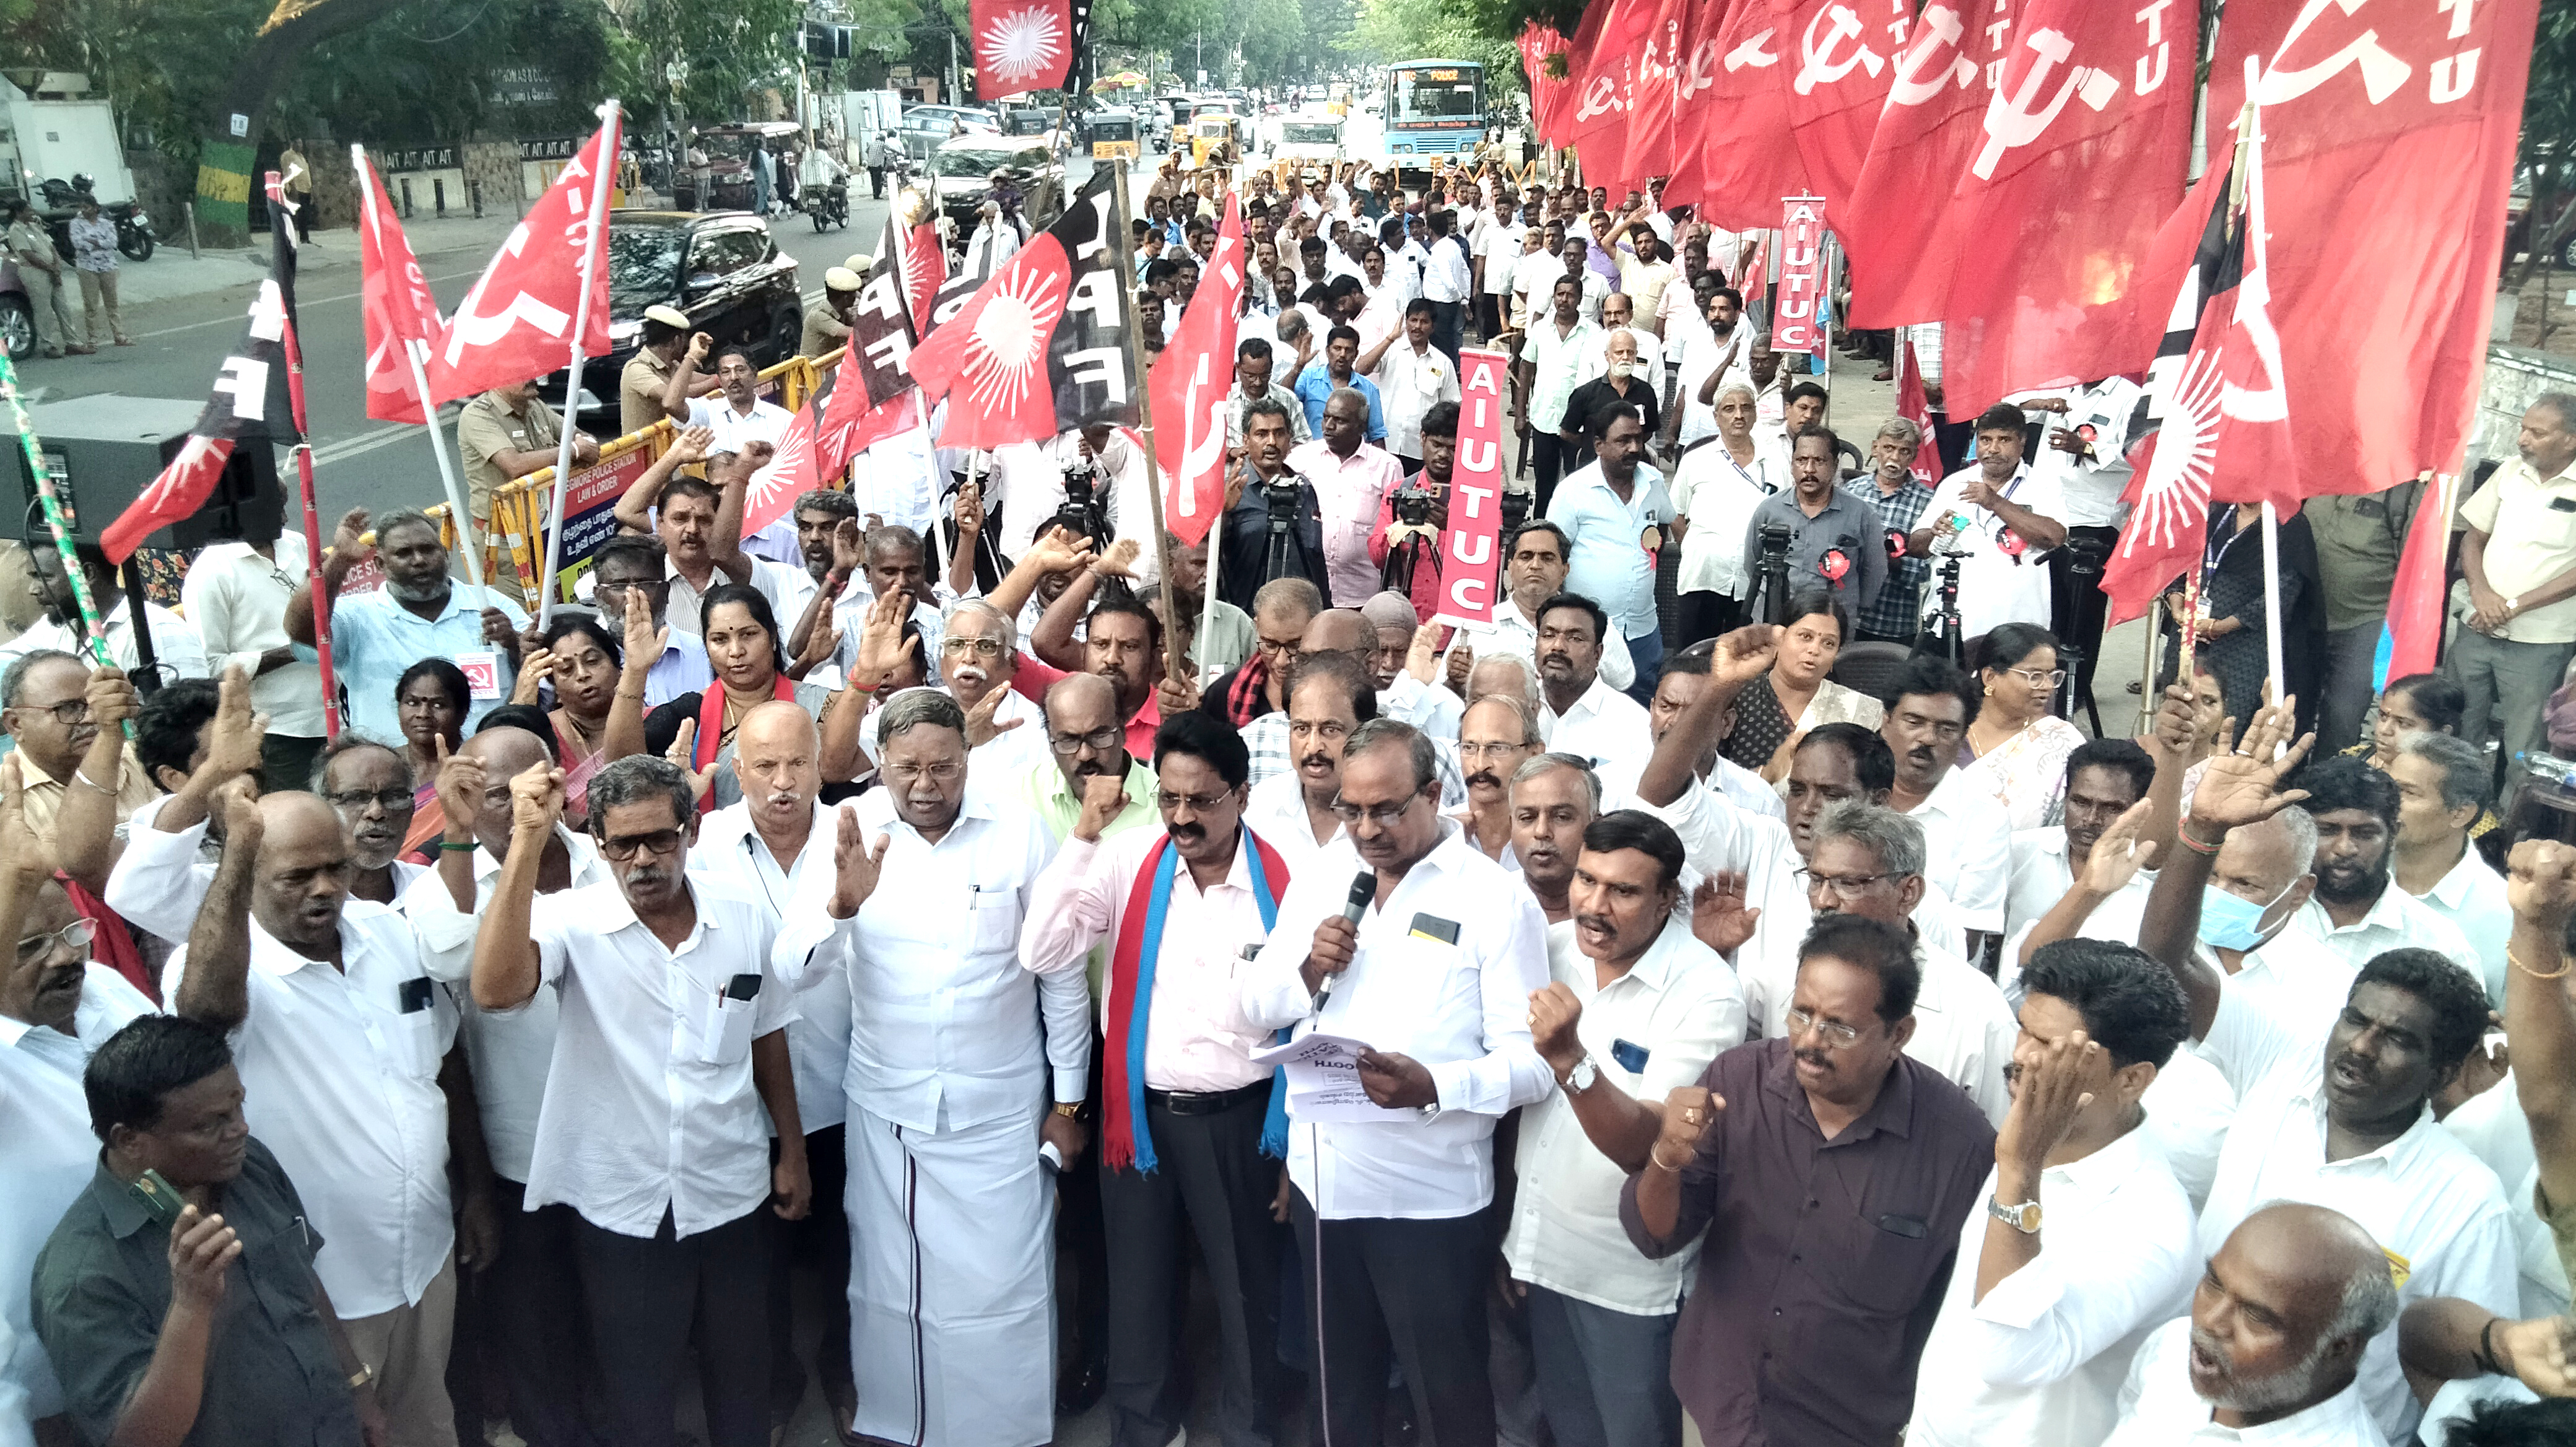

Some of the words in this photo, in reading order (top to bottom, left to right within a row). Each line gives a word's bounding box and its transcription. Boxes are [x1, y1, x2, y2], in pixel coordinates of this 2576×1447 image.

[1430, 69, 1458, 81] POLICE
[1780, 205, 1817, 344] AIUTUC
[592, 461, 614, 481] POLICE
[613, 452, 637, 471] STATION
[577, 487, 591, 503] LAW
[591, 484, 596, 497] &
[596, 475, 618, 494] ORDER
[1450, 362, 1497, 611] AIUTUC
